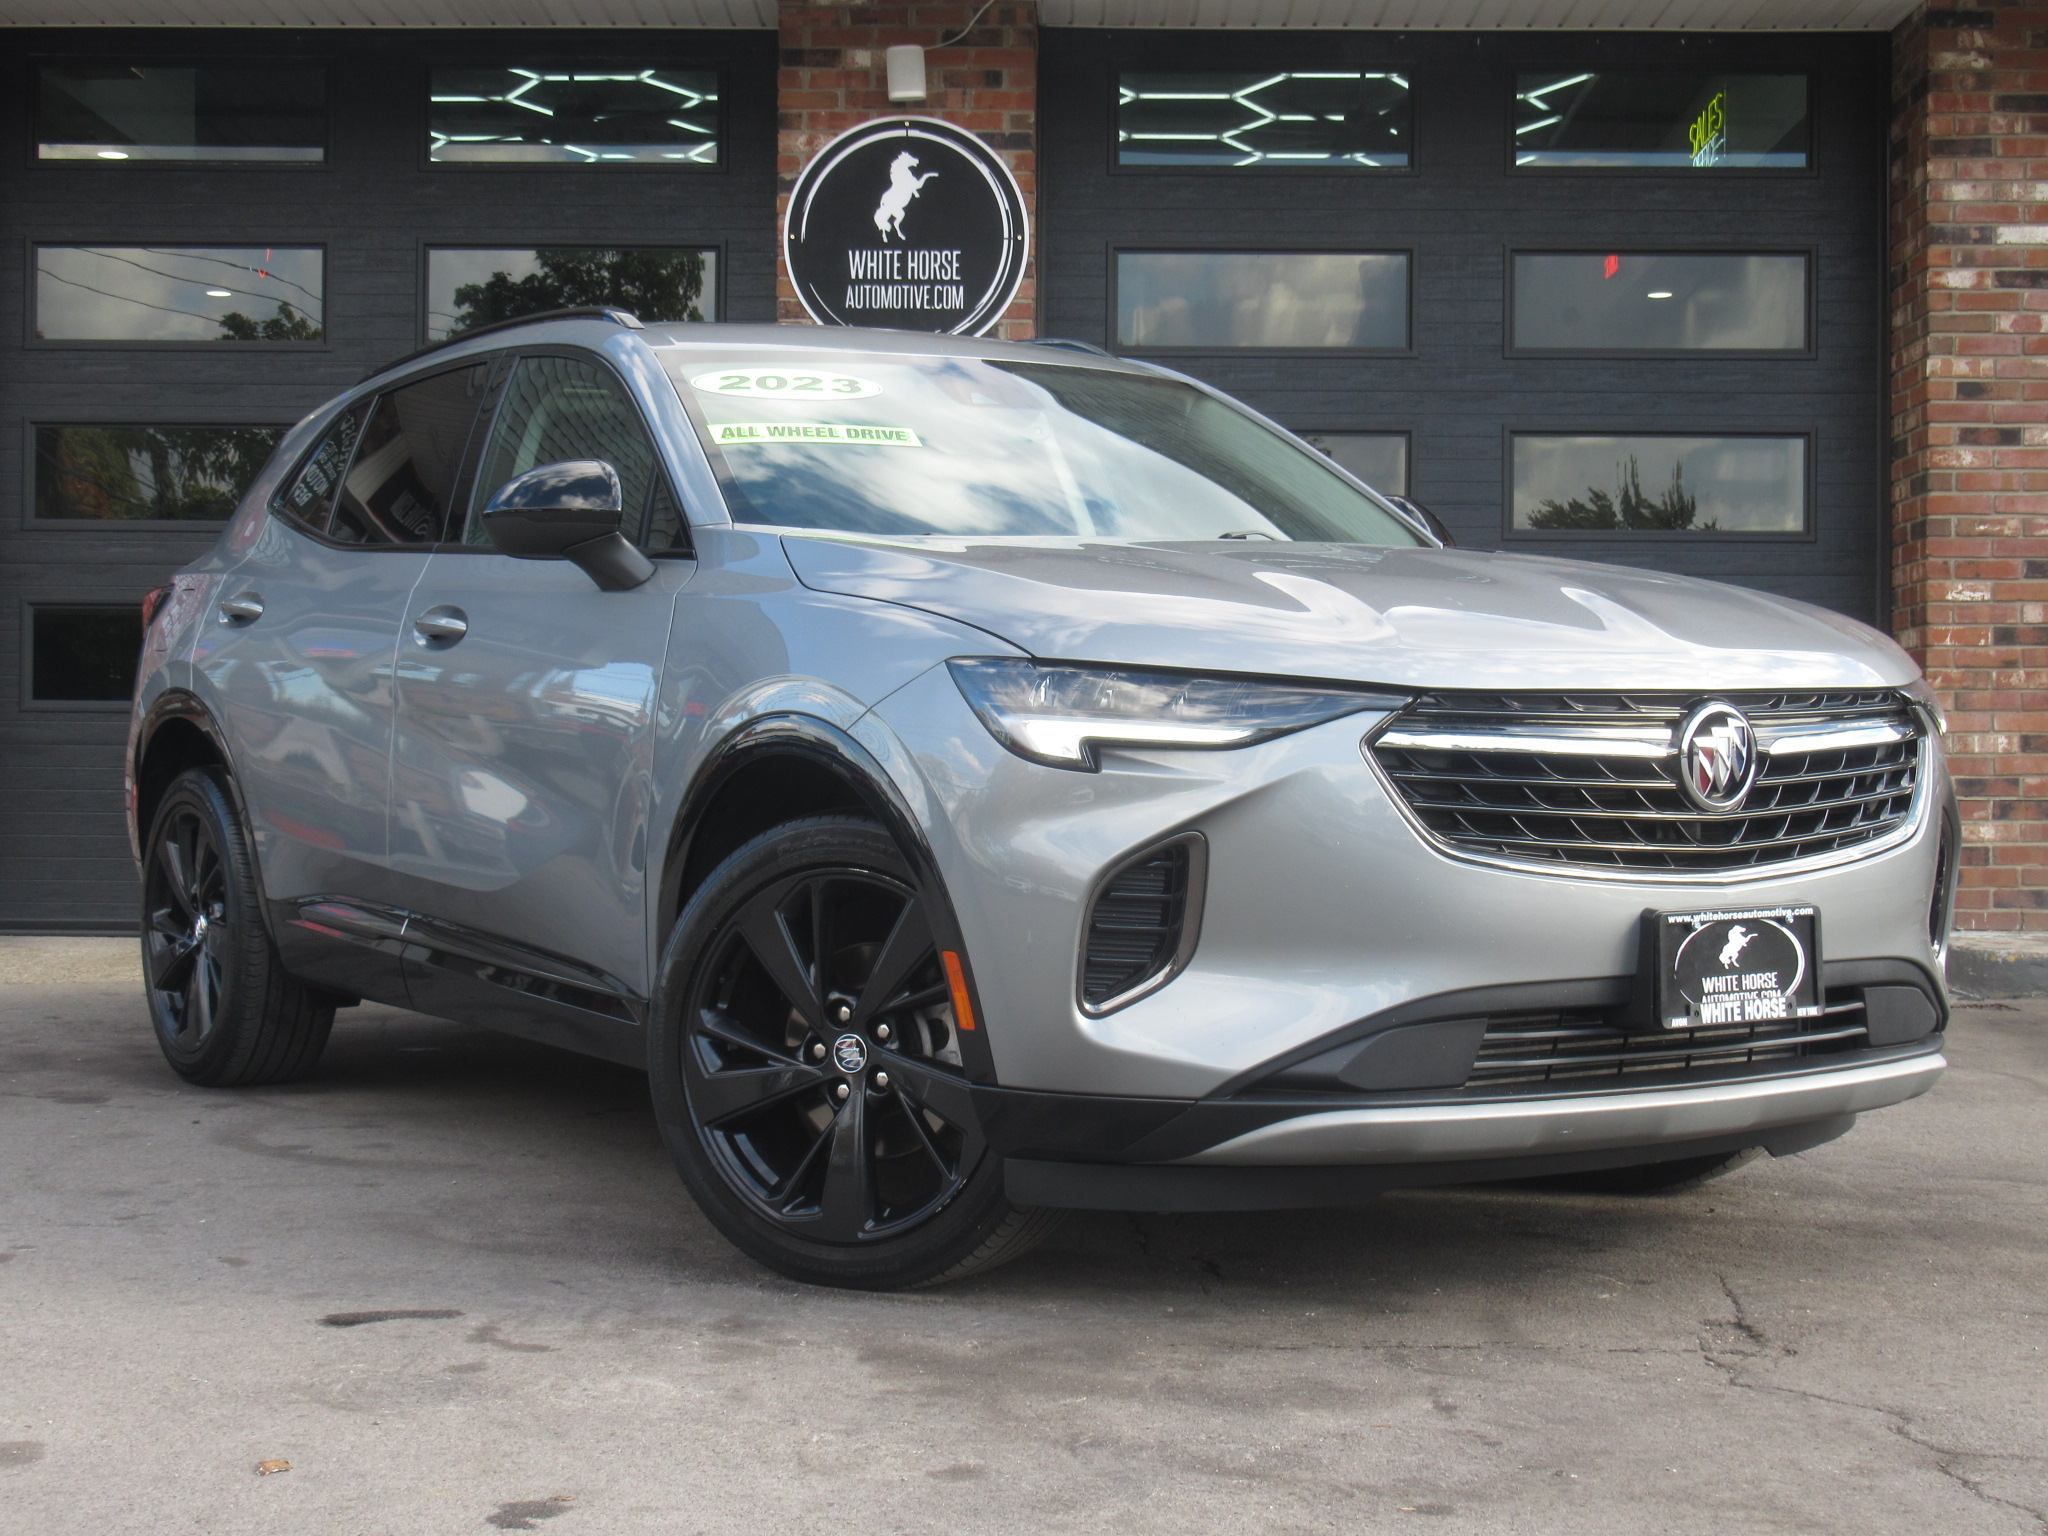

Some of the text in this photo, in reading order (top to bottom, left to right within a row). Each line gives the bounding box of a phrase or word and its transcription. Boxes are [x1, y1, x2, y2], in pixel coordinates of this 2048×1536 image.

[1689, 93, 1724, 159] SALES
[848, 250, 962, 281] WHITE HORSE
[845, 284, 964, 310] AUTOMOTIVE.COM
[718, 375, 863, 394] 2023
[720, 425, 909, 442] ALL WHEEL DRIVE
[1667, 907, 1814, 924] www.whitehorseautomotive.com
[1702, 971, 1779, 994] WHITE HORSE
[1701, 989, 1782, 1004] AUTOMOTIVECOM
[1700, 997, 1787, 1024] WHITE HORSE
[1671, 1017, 1688, 1028] AVON
